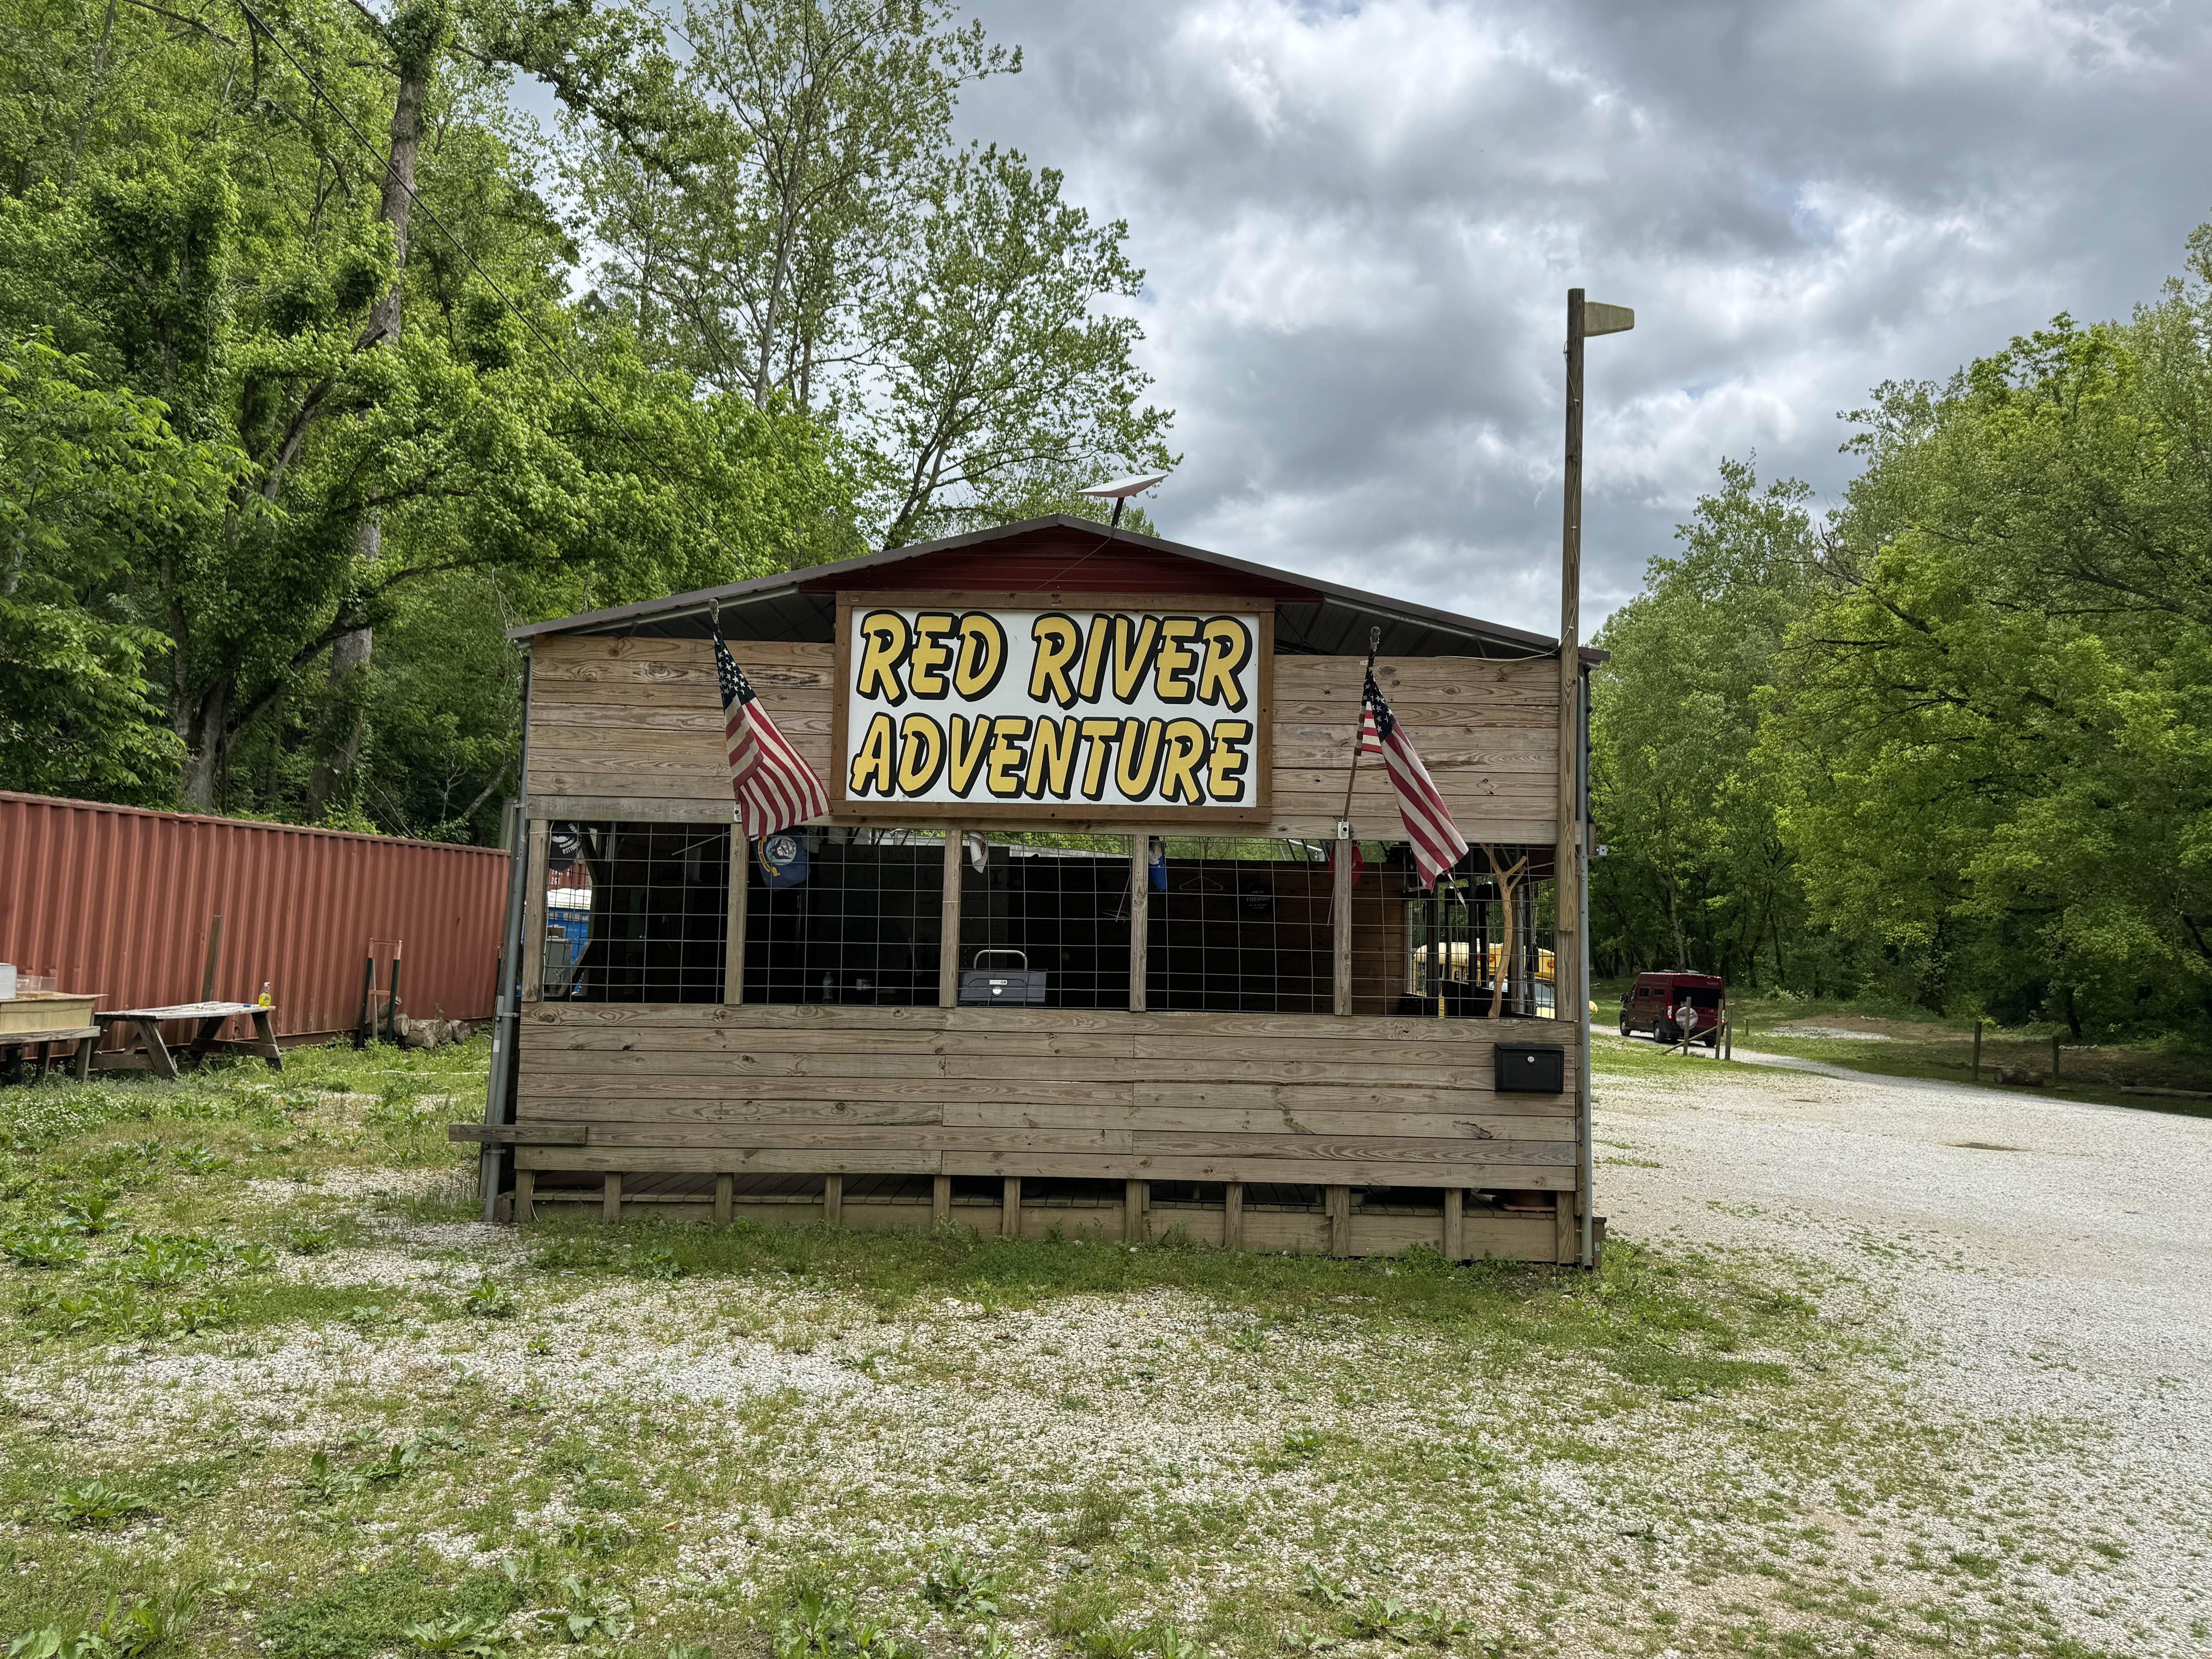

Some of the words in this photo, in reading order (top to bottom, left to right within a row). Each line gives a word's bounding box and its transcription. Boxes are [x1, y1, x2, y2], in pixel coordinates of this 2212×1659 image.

[857, 610, 1008, 707] RED
[1028, 613, 1253, 713] RIVER
[850, 712, 1253, 806] ADVENTURE
